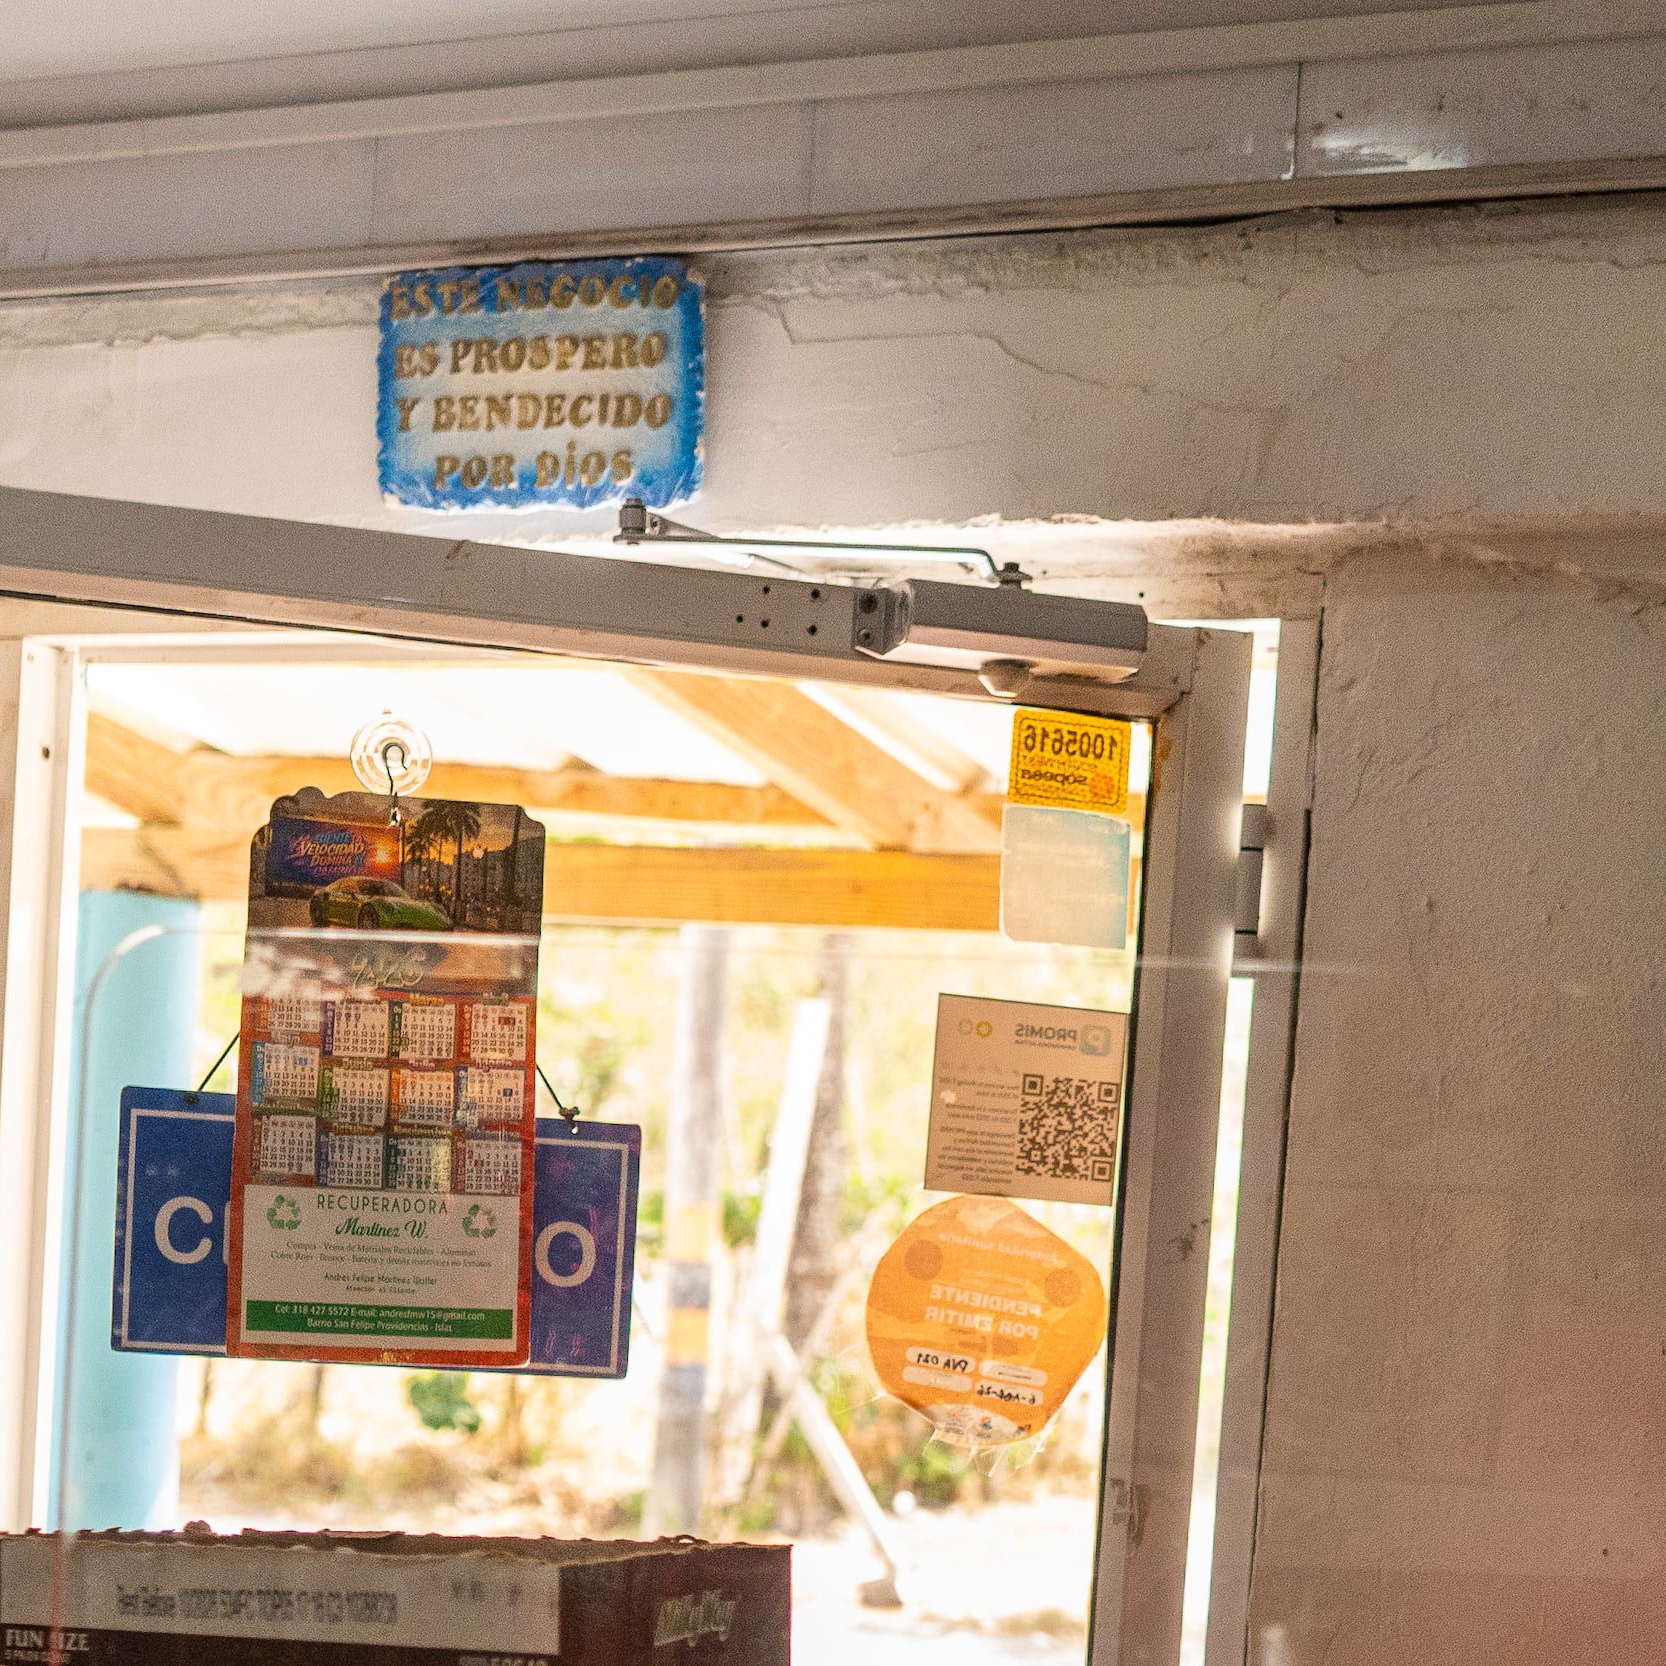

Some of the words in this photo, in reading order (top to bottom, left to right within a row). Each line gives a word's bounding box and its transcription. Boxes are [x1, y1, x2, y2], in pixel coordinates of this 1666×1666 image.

[390, 279, 481, 321] ESTE
[496, 274, 679, 314] NEGOCIO
[395, 342, 439, 378] ES
[449, 332, 667, 374] PROSPERO
[397, 398, 422, 431] Y
[432, 393, 672, 432] BENDECIDO
[435, 453, 516, 489] POR
[317, 1194, 448, 1214] RECUPERADORA
[310, 1307, 325, 1316] 427
[334, 1319, 349, 1328] San
[351, 1319, 375, 1330] Felipe
[6, 1630, 44, 1649] FUN
